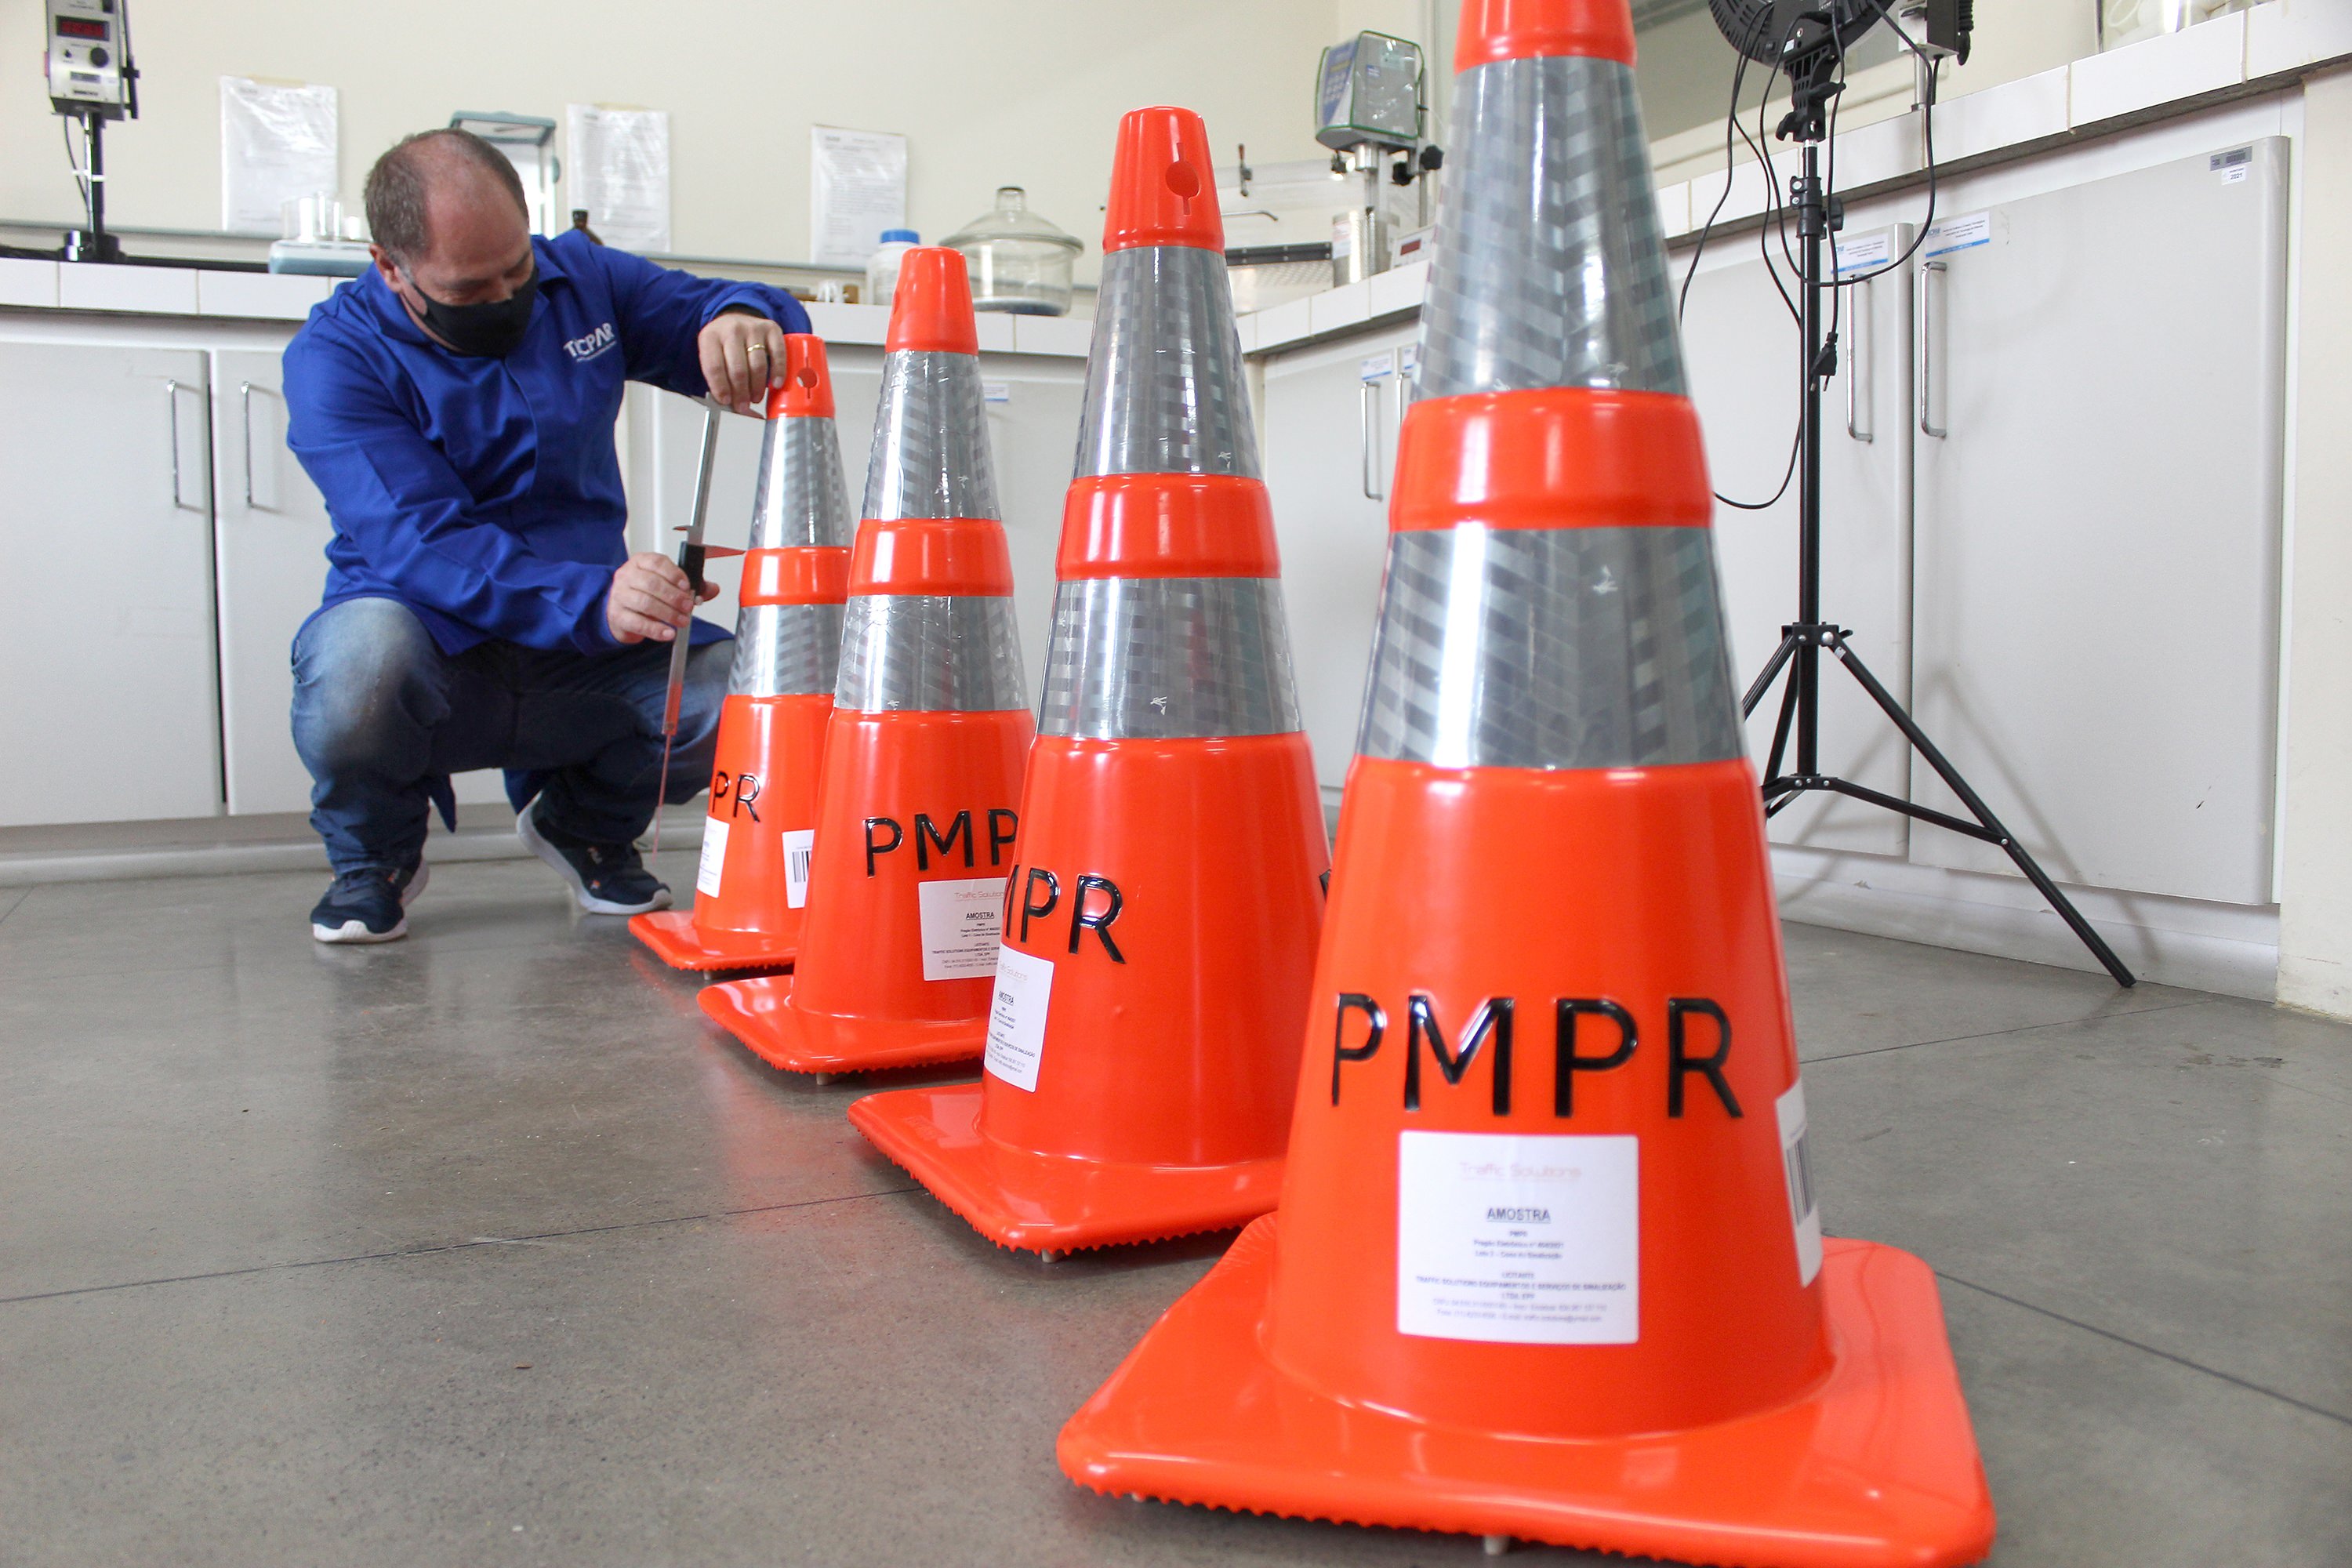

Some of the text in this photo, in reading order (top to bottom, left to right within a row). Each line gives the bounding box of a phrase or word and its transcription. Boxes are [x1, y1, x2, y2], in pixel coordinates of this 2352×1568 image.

[712, 771, 760, 822] PR
[863, 808, 1018, 878] PMP
[966, 912, 995, 920] AMOSTRA
[1332, 993, 1744, 1118] PMPR
[1487, 1207, 1551, 1222] AMOSTRA
